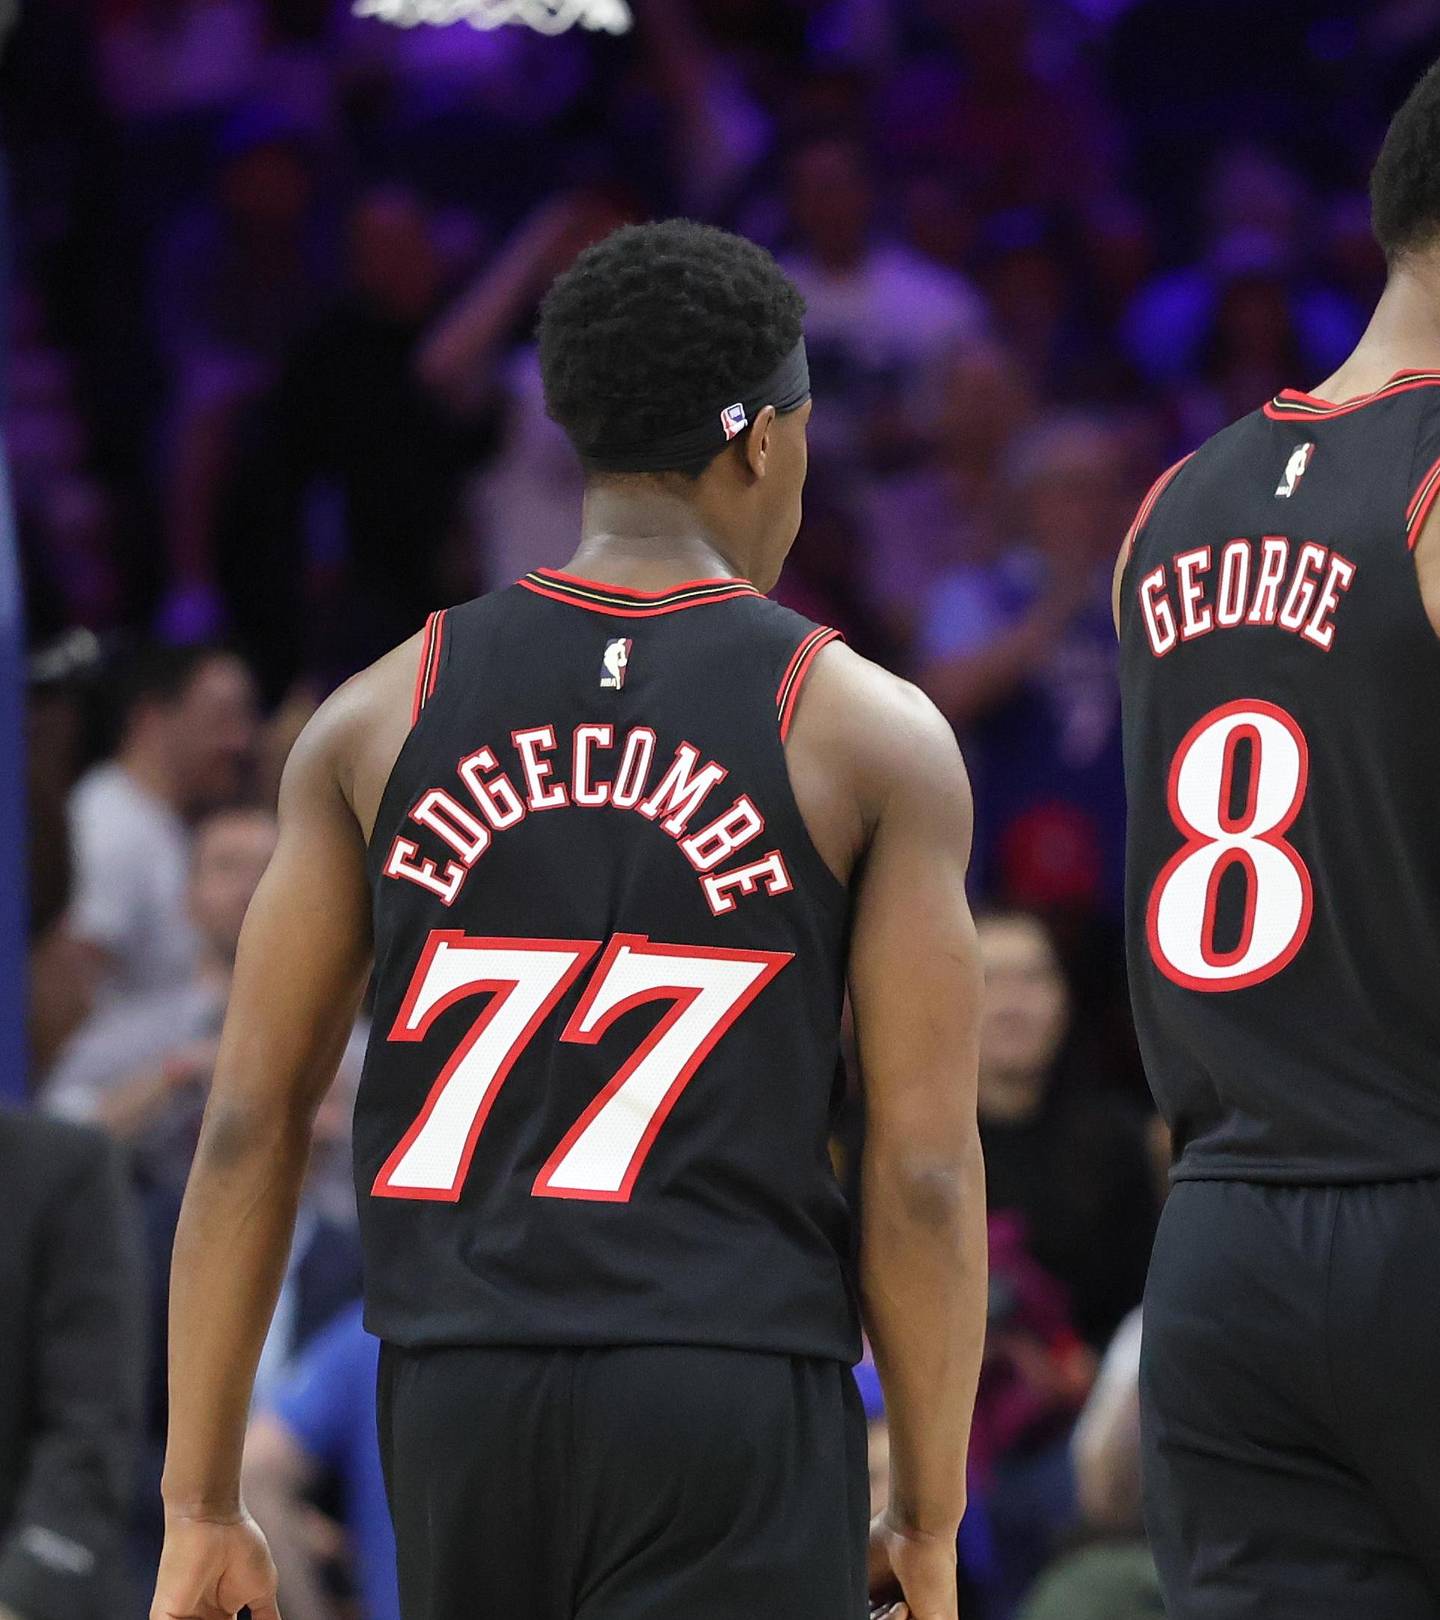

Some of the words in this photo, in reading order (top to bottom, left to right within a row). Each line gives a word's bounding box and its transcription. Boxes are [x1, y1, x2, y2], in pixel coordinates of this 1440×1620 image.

[1138, 536, 1356, 657] GEORGE
[383, 723, 794, 916] EDGECOMBE
[1146, 698, 1313, 992] 8
[370, 929, 796, 1202] 77
